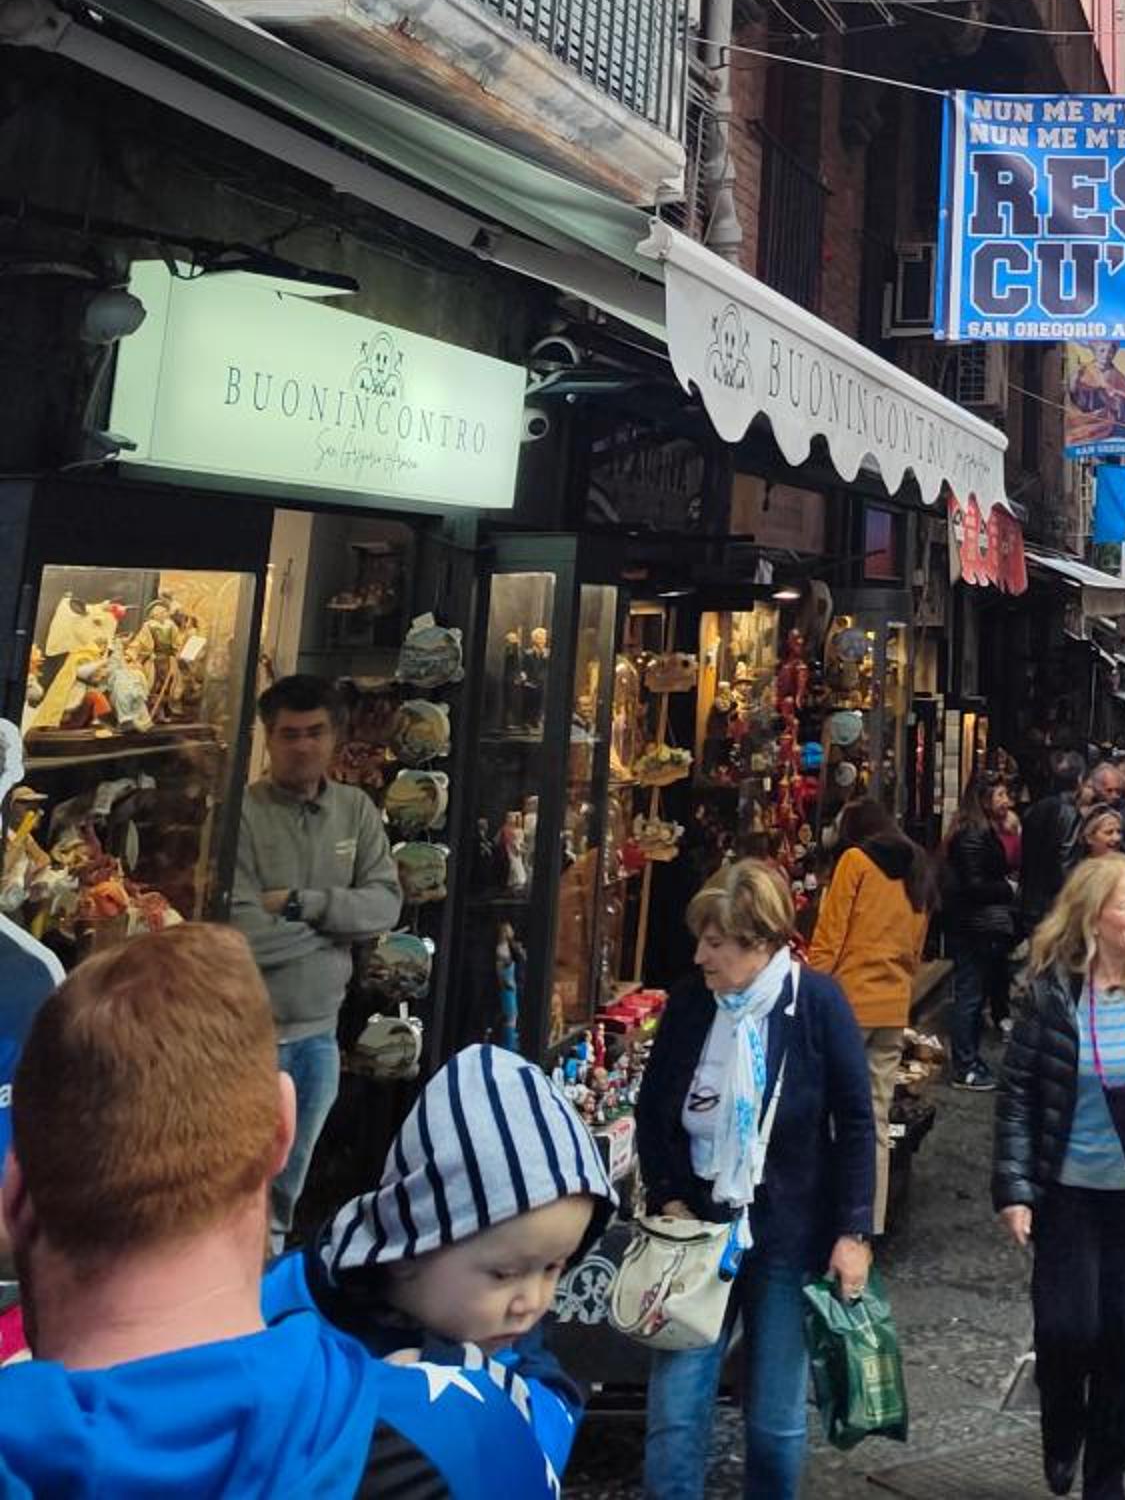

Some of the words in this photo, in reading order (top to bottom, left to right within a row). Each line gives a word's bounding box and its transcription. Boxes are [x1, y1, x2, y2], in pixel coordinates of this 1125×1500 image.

[973, 98, 1033, 122] NUN
[1043, 100, 1084, 122] ME
[970, 123, 1029, 147] NUN
[1037, 127, 1077, 149] ME
[968, 322, 1008, 338] SAN
[224, 366, 487, 455] BUONINCONTRO
[767, 337, 947, 472] BUONINCONTRO
